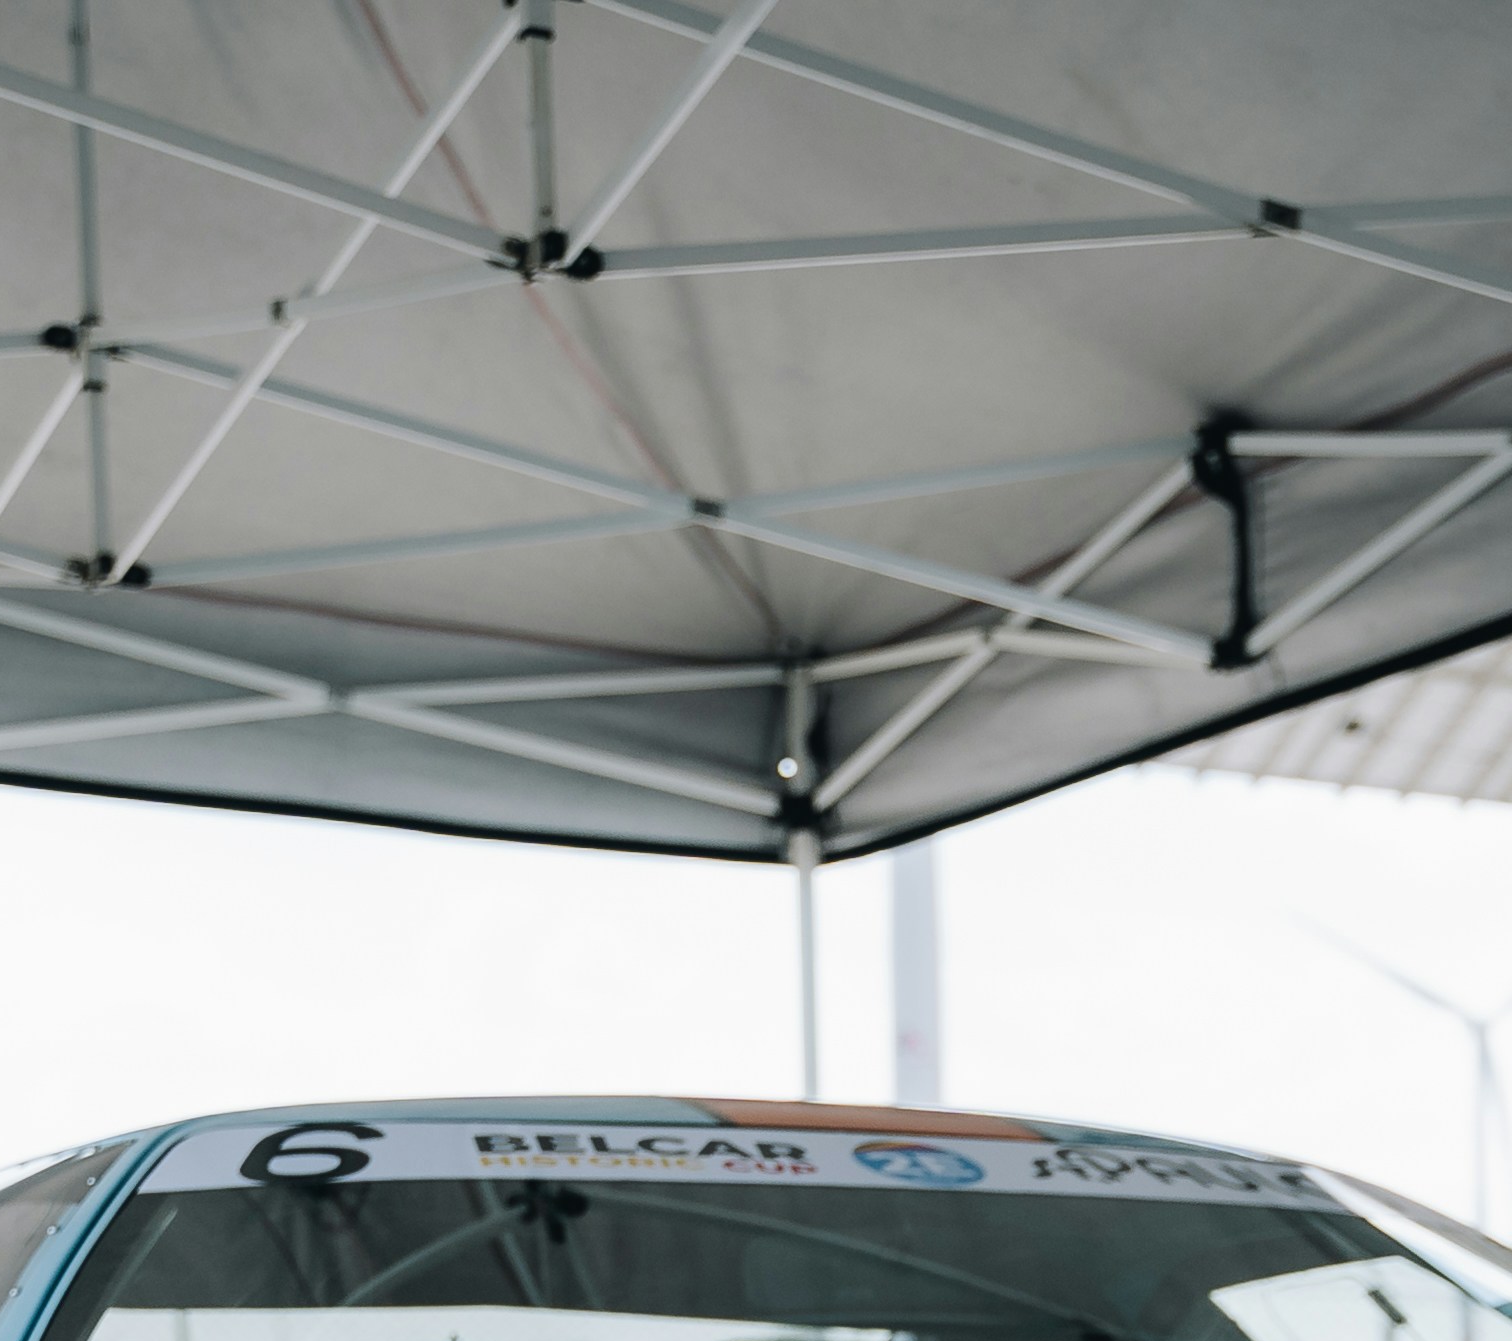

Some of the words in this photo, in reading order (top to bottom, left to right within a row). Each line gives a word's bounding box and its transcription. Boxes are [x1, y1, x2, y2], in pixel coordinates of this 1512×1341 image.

[239, 1121, 383, 1182] 6
[474, 1133, 810, 1160] BELCAR
[722, 1159, 819, 1175] CUP
